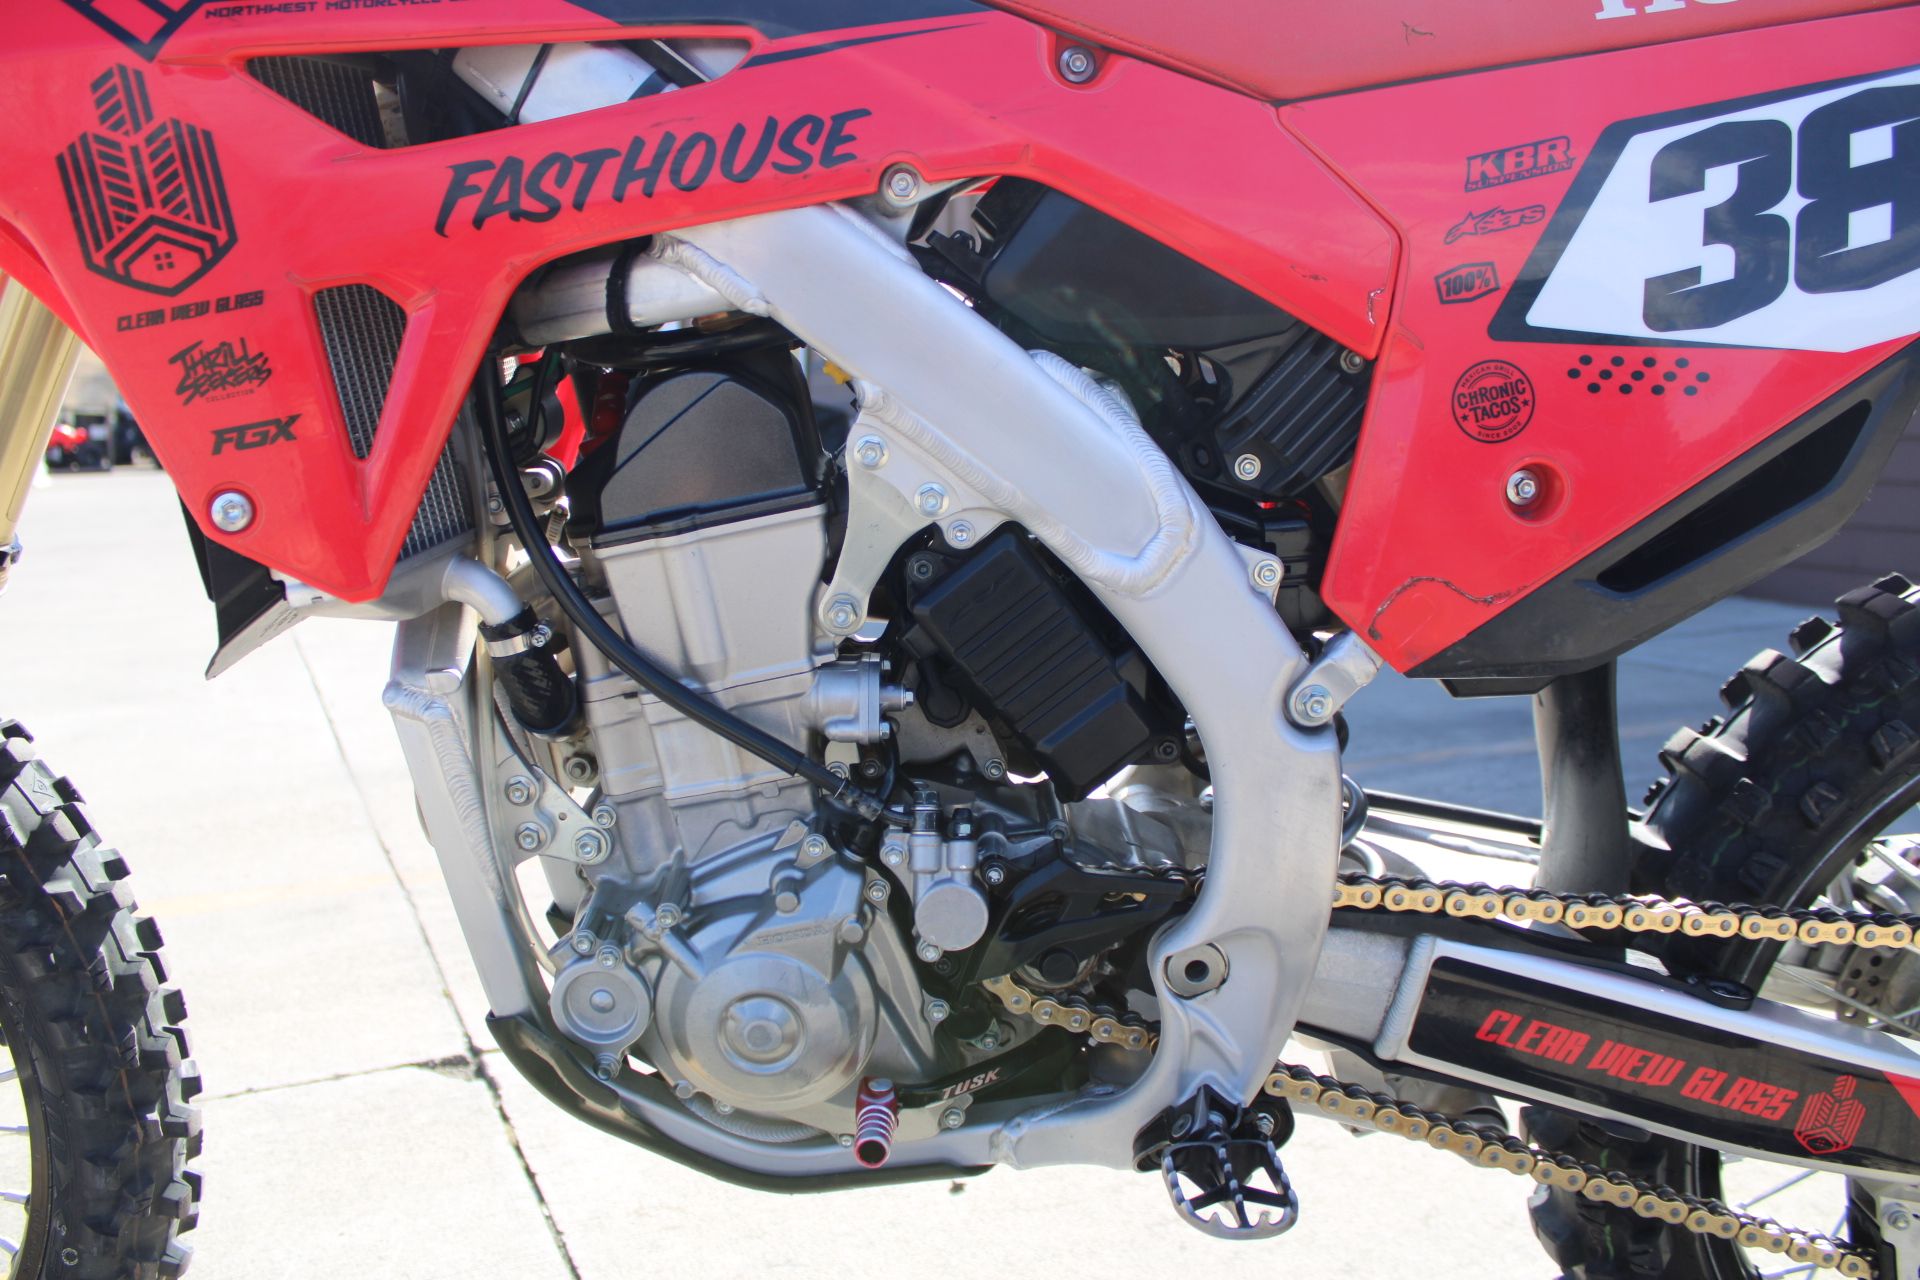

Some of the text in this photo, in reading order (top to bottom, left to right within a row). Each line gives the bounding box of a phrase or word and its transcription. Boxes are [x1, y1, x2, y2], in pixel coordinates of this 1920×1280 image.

[205, 0, 441, 19] NORTHWEST MOTORCY
[434, 108, 872, 238] FASTHOUSE
[1468, 138, 1569, 183] KBR
[1642, 82, 1920, 333] 38
[1444, 268, 1491, 297] 100%
[117, 290, 264, 332] CLEAR VIEW GLASS
[168, 337, 264, 377] THRILL
[1457, 378, 1526, 409] CHRONIC
[1468, 397, 1521, 423] TACOS
[211, 413, 302, 456] FGX
[943, 1067, 1002, 1101] TUSK
[1475, 1009, 1798, 1121] CLEAR VIEW GLASS
